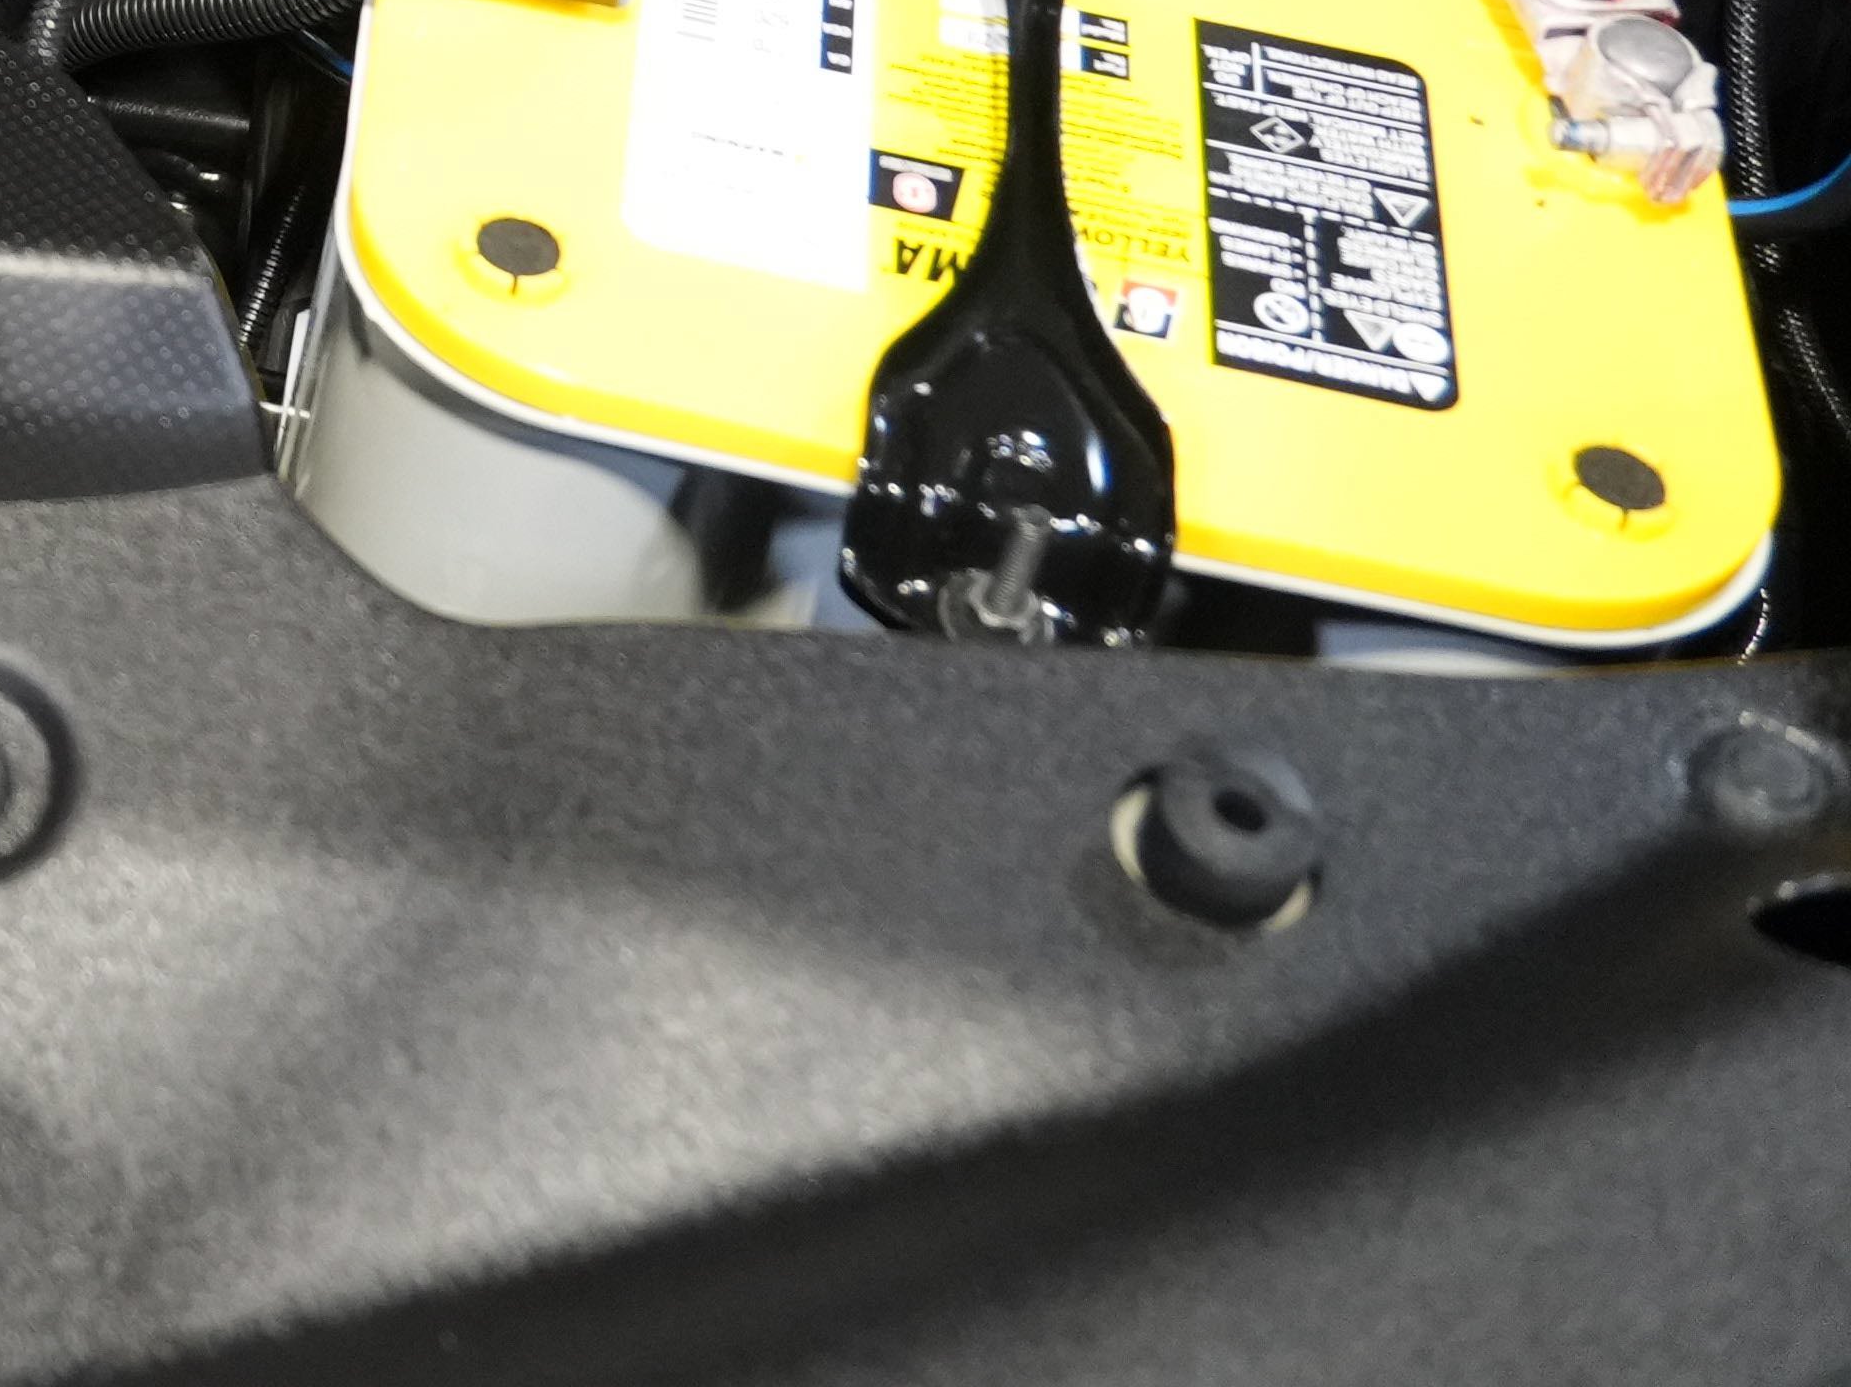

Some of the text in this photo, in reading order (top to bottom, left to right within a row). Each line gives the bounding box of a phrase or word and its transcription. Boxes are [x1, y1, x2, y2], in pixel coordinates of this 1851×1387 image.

[1262, 102, 1308, 123] HELP
[1220, 234, 1291, 262] FLAMES
[1270, 276, 1305, 298] NO
[1216, 330, 1409, 392] DANGER/POISON
